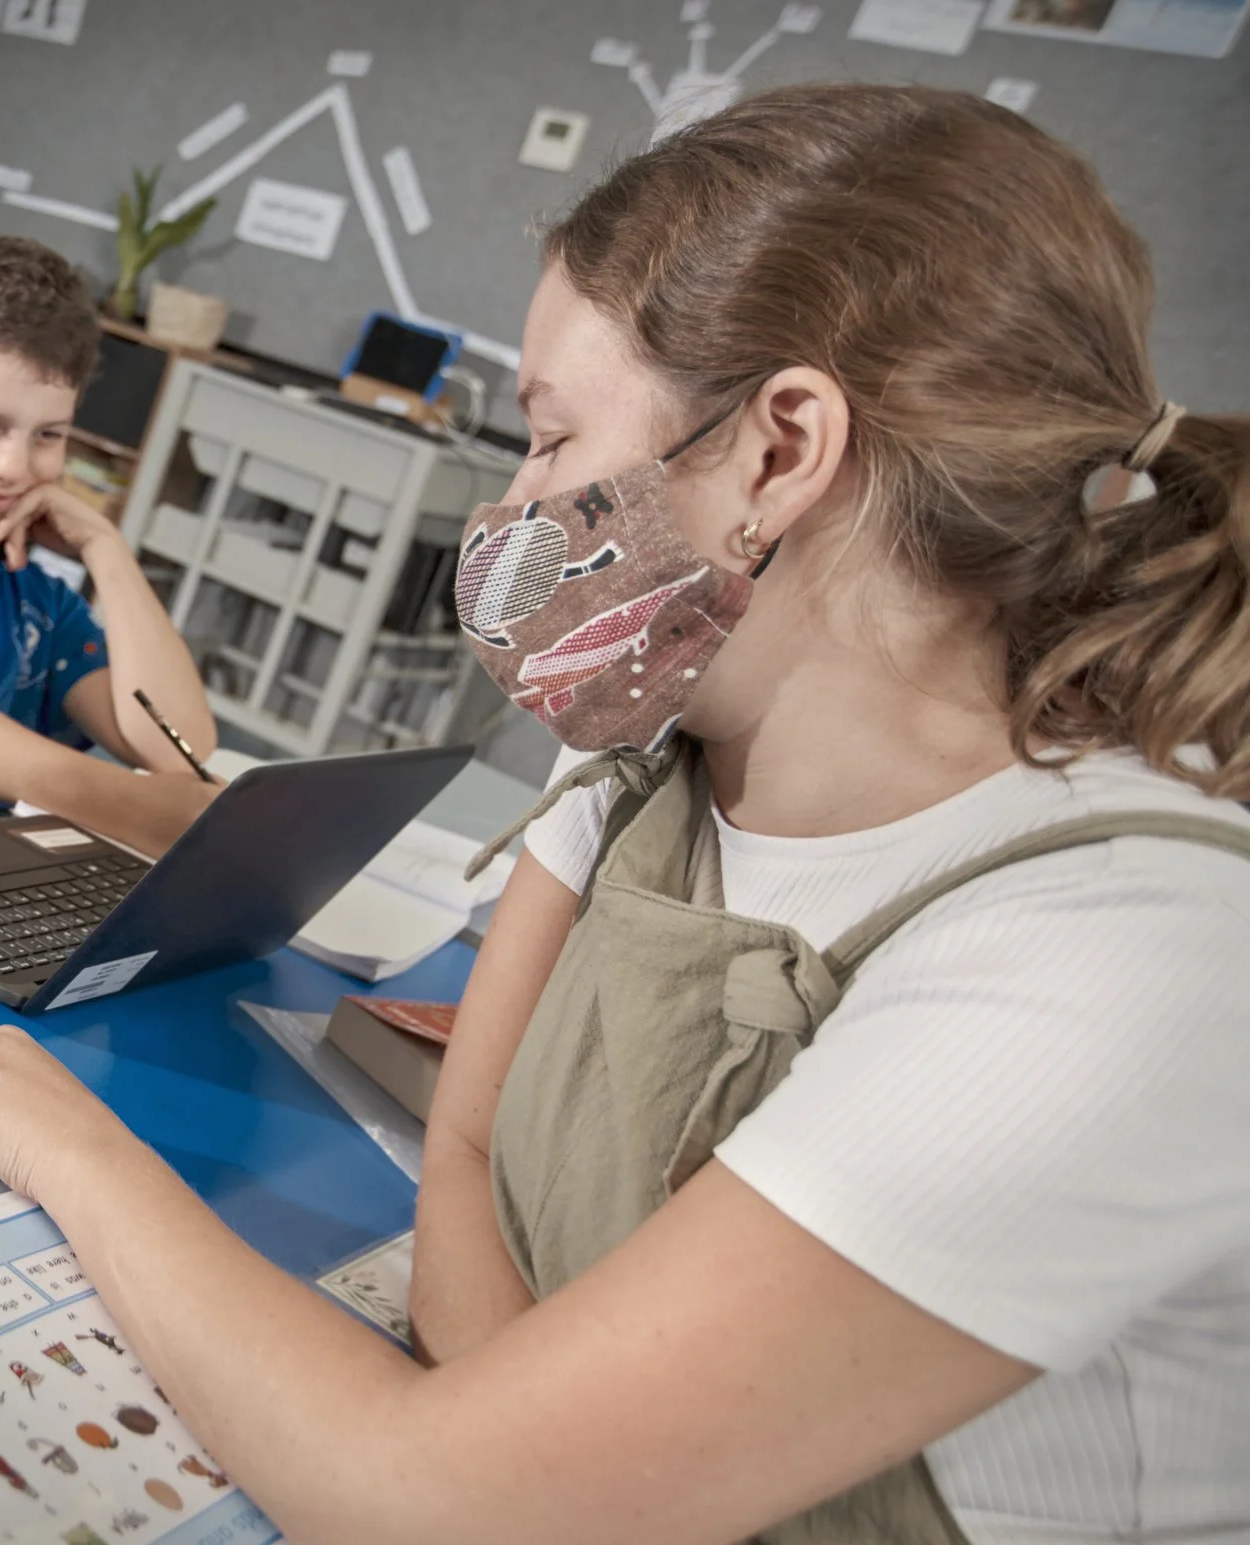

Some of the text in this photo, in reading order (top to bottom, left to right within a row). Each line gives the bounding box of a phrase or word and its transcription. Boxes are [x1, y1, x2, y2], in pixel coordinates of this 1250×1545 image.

[26, 1250, 77, 1275] e here like
[50, 1273, 87, 1291] was is
[0, 1299, 18, 1312] she
